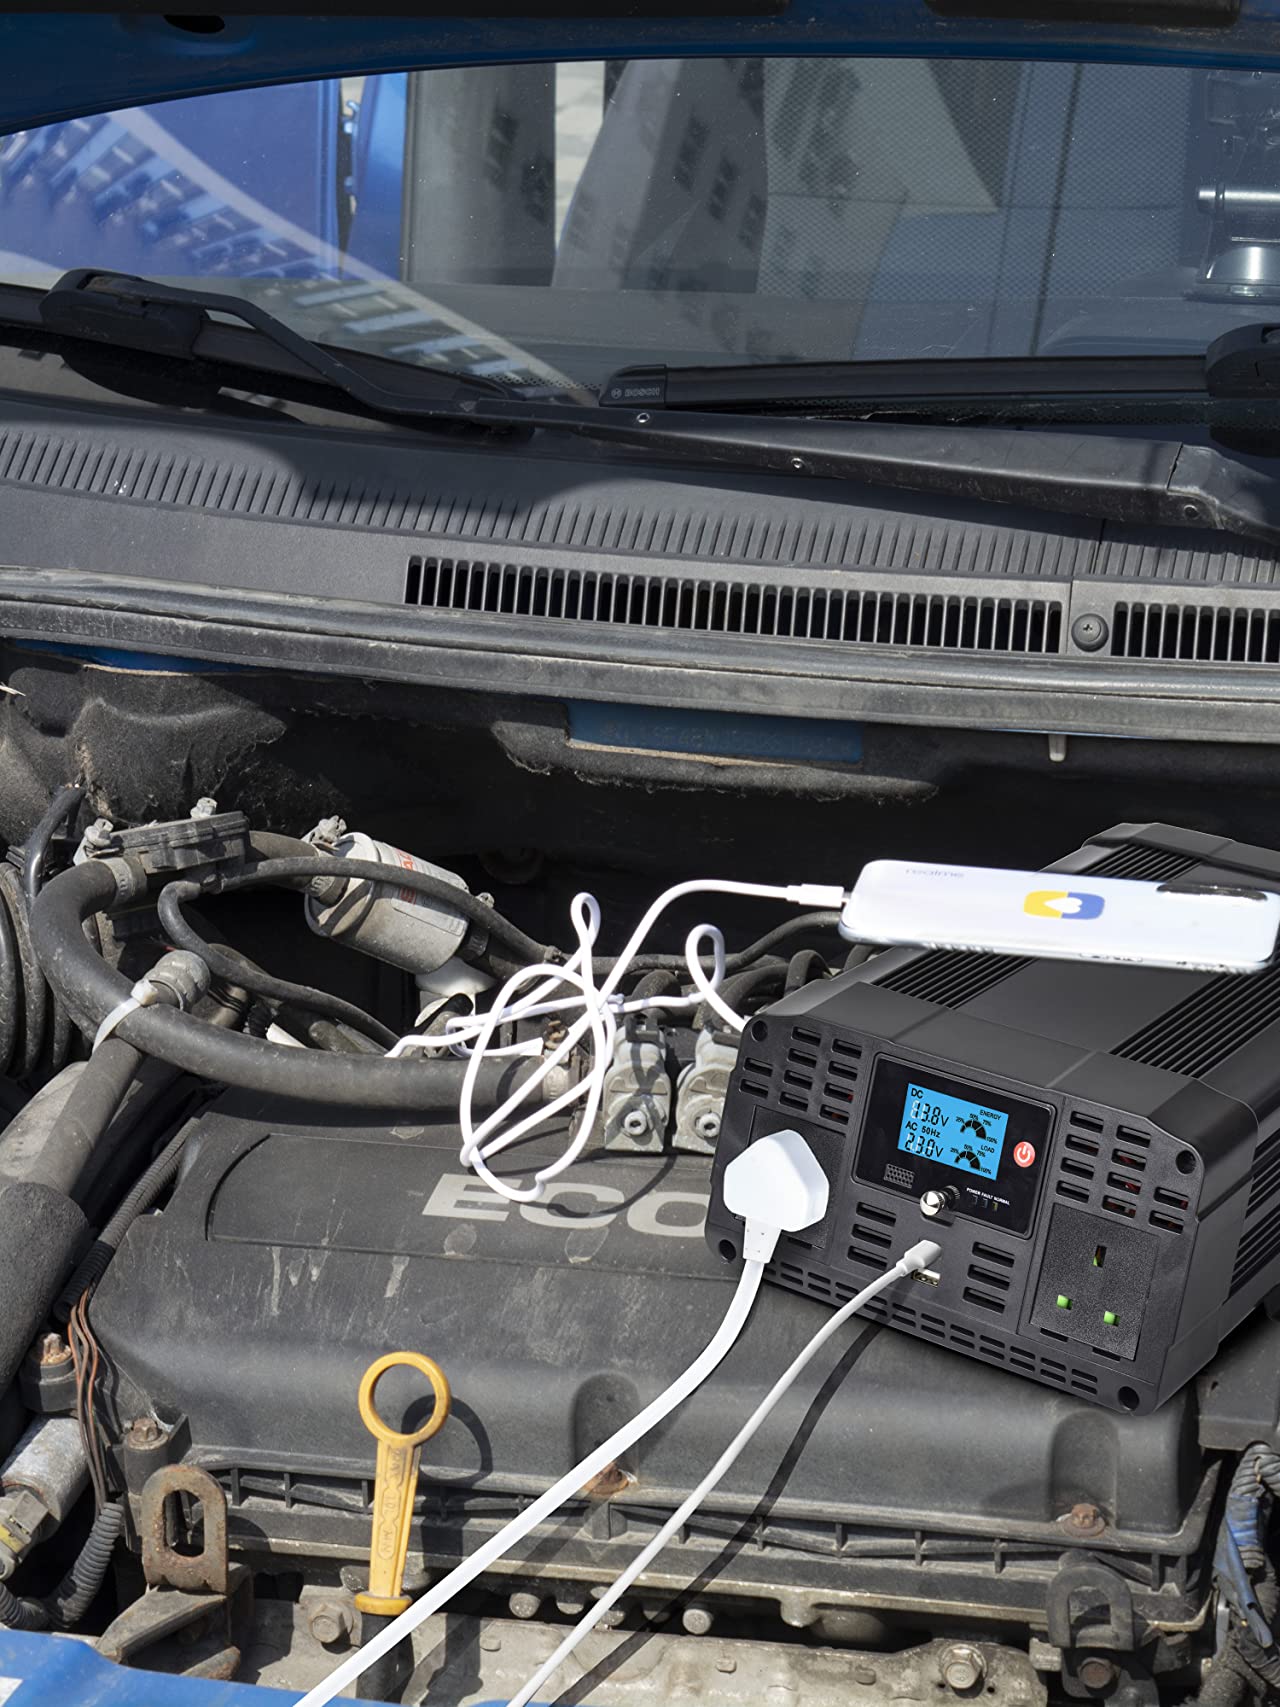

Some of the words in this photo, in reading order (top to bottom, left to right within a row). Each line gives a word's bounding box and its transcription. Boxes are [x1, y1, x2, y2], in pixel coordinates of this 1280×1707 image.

[624, 387, 660, 397] BOSCH
[911, 1087, 924, 1099] DC
[979, 1109, 1001, 1120] ENERGY
[905, 1120, 918, 1131] AC
[921, 1126, 941, 1138] 50Hz
[980, 1144, 995, 1154] LOAD
[966, 1187, 981, 1195] POWER
[421, 1173, 710, 1238] ECO
